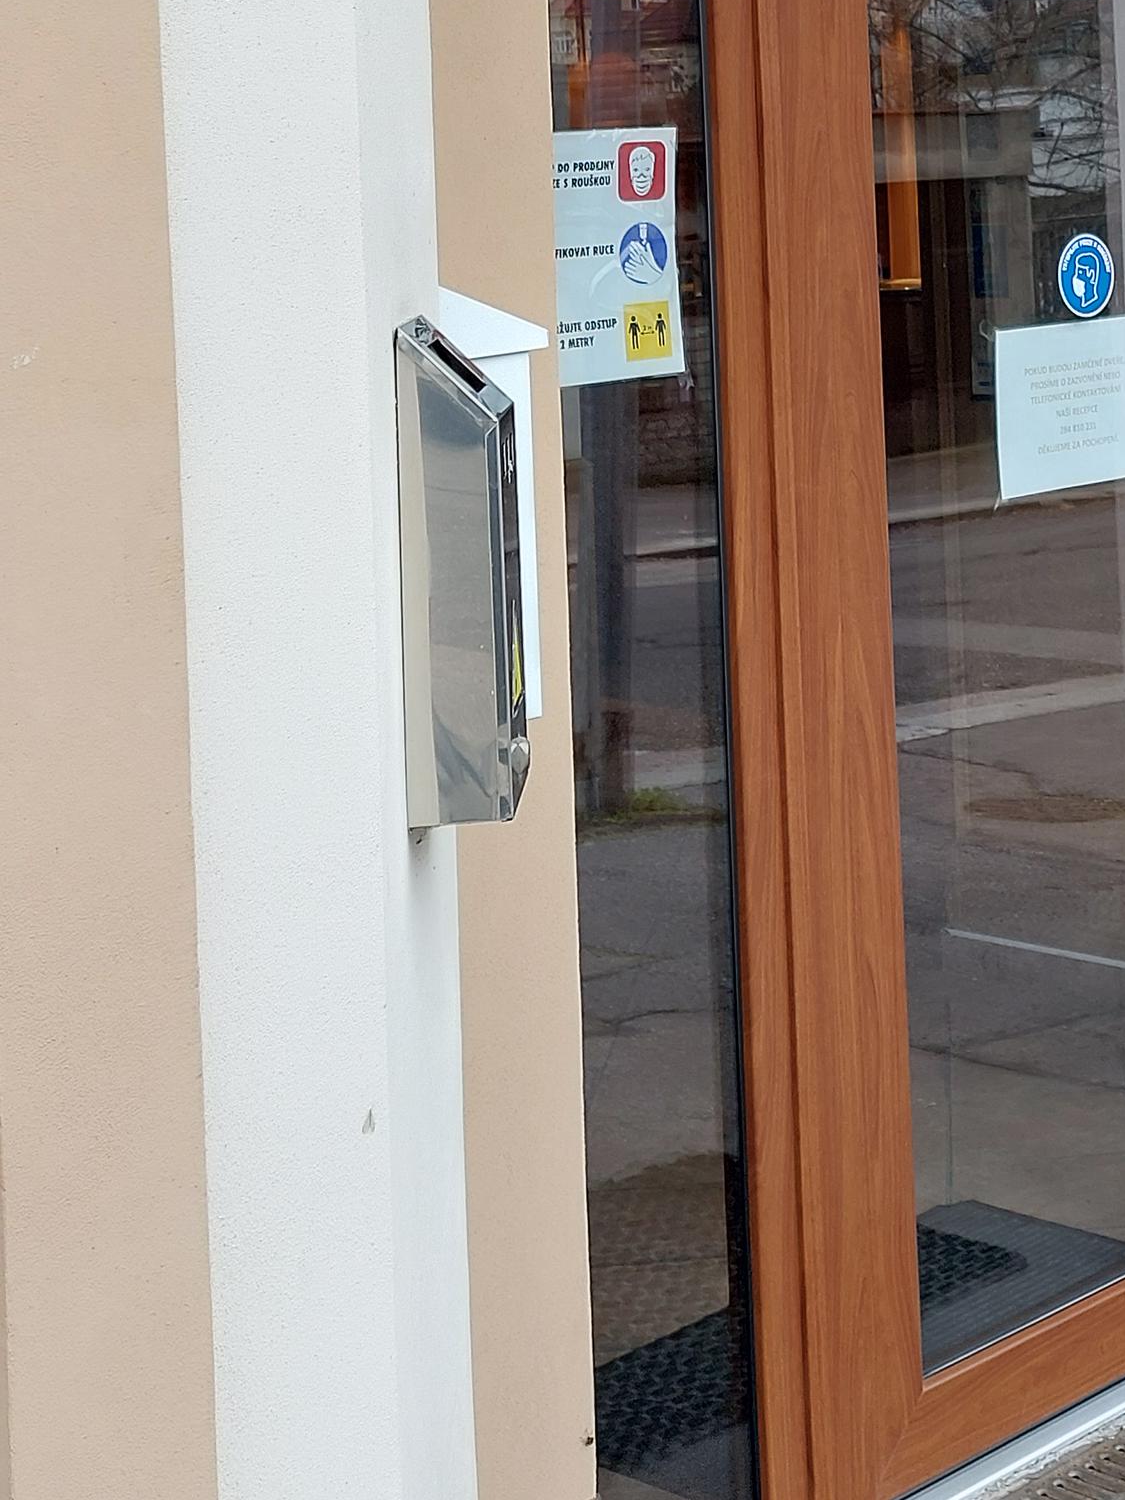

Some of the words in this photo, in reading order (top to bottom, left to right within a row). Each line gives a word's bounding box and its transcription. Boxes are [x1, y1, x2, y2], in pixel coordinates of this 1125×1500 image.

[557, 163, 570, 173] DO
[573, 160, 615, 172] PRODEJNY
[563, 178, 569, 189] S
[571, 174, 611, 188] ROUŠKOU
[555, 246, 590, 259] FIKOVAT
[592, 244, 615, 256] RUCE
[584, 318, 618, 331] ODSTUP
[560, 339, 565, 350] 2
[568, 336, 594, 349] METRY
